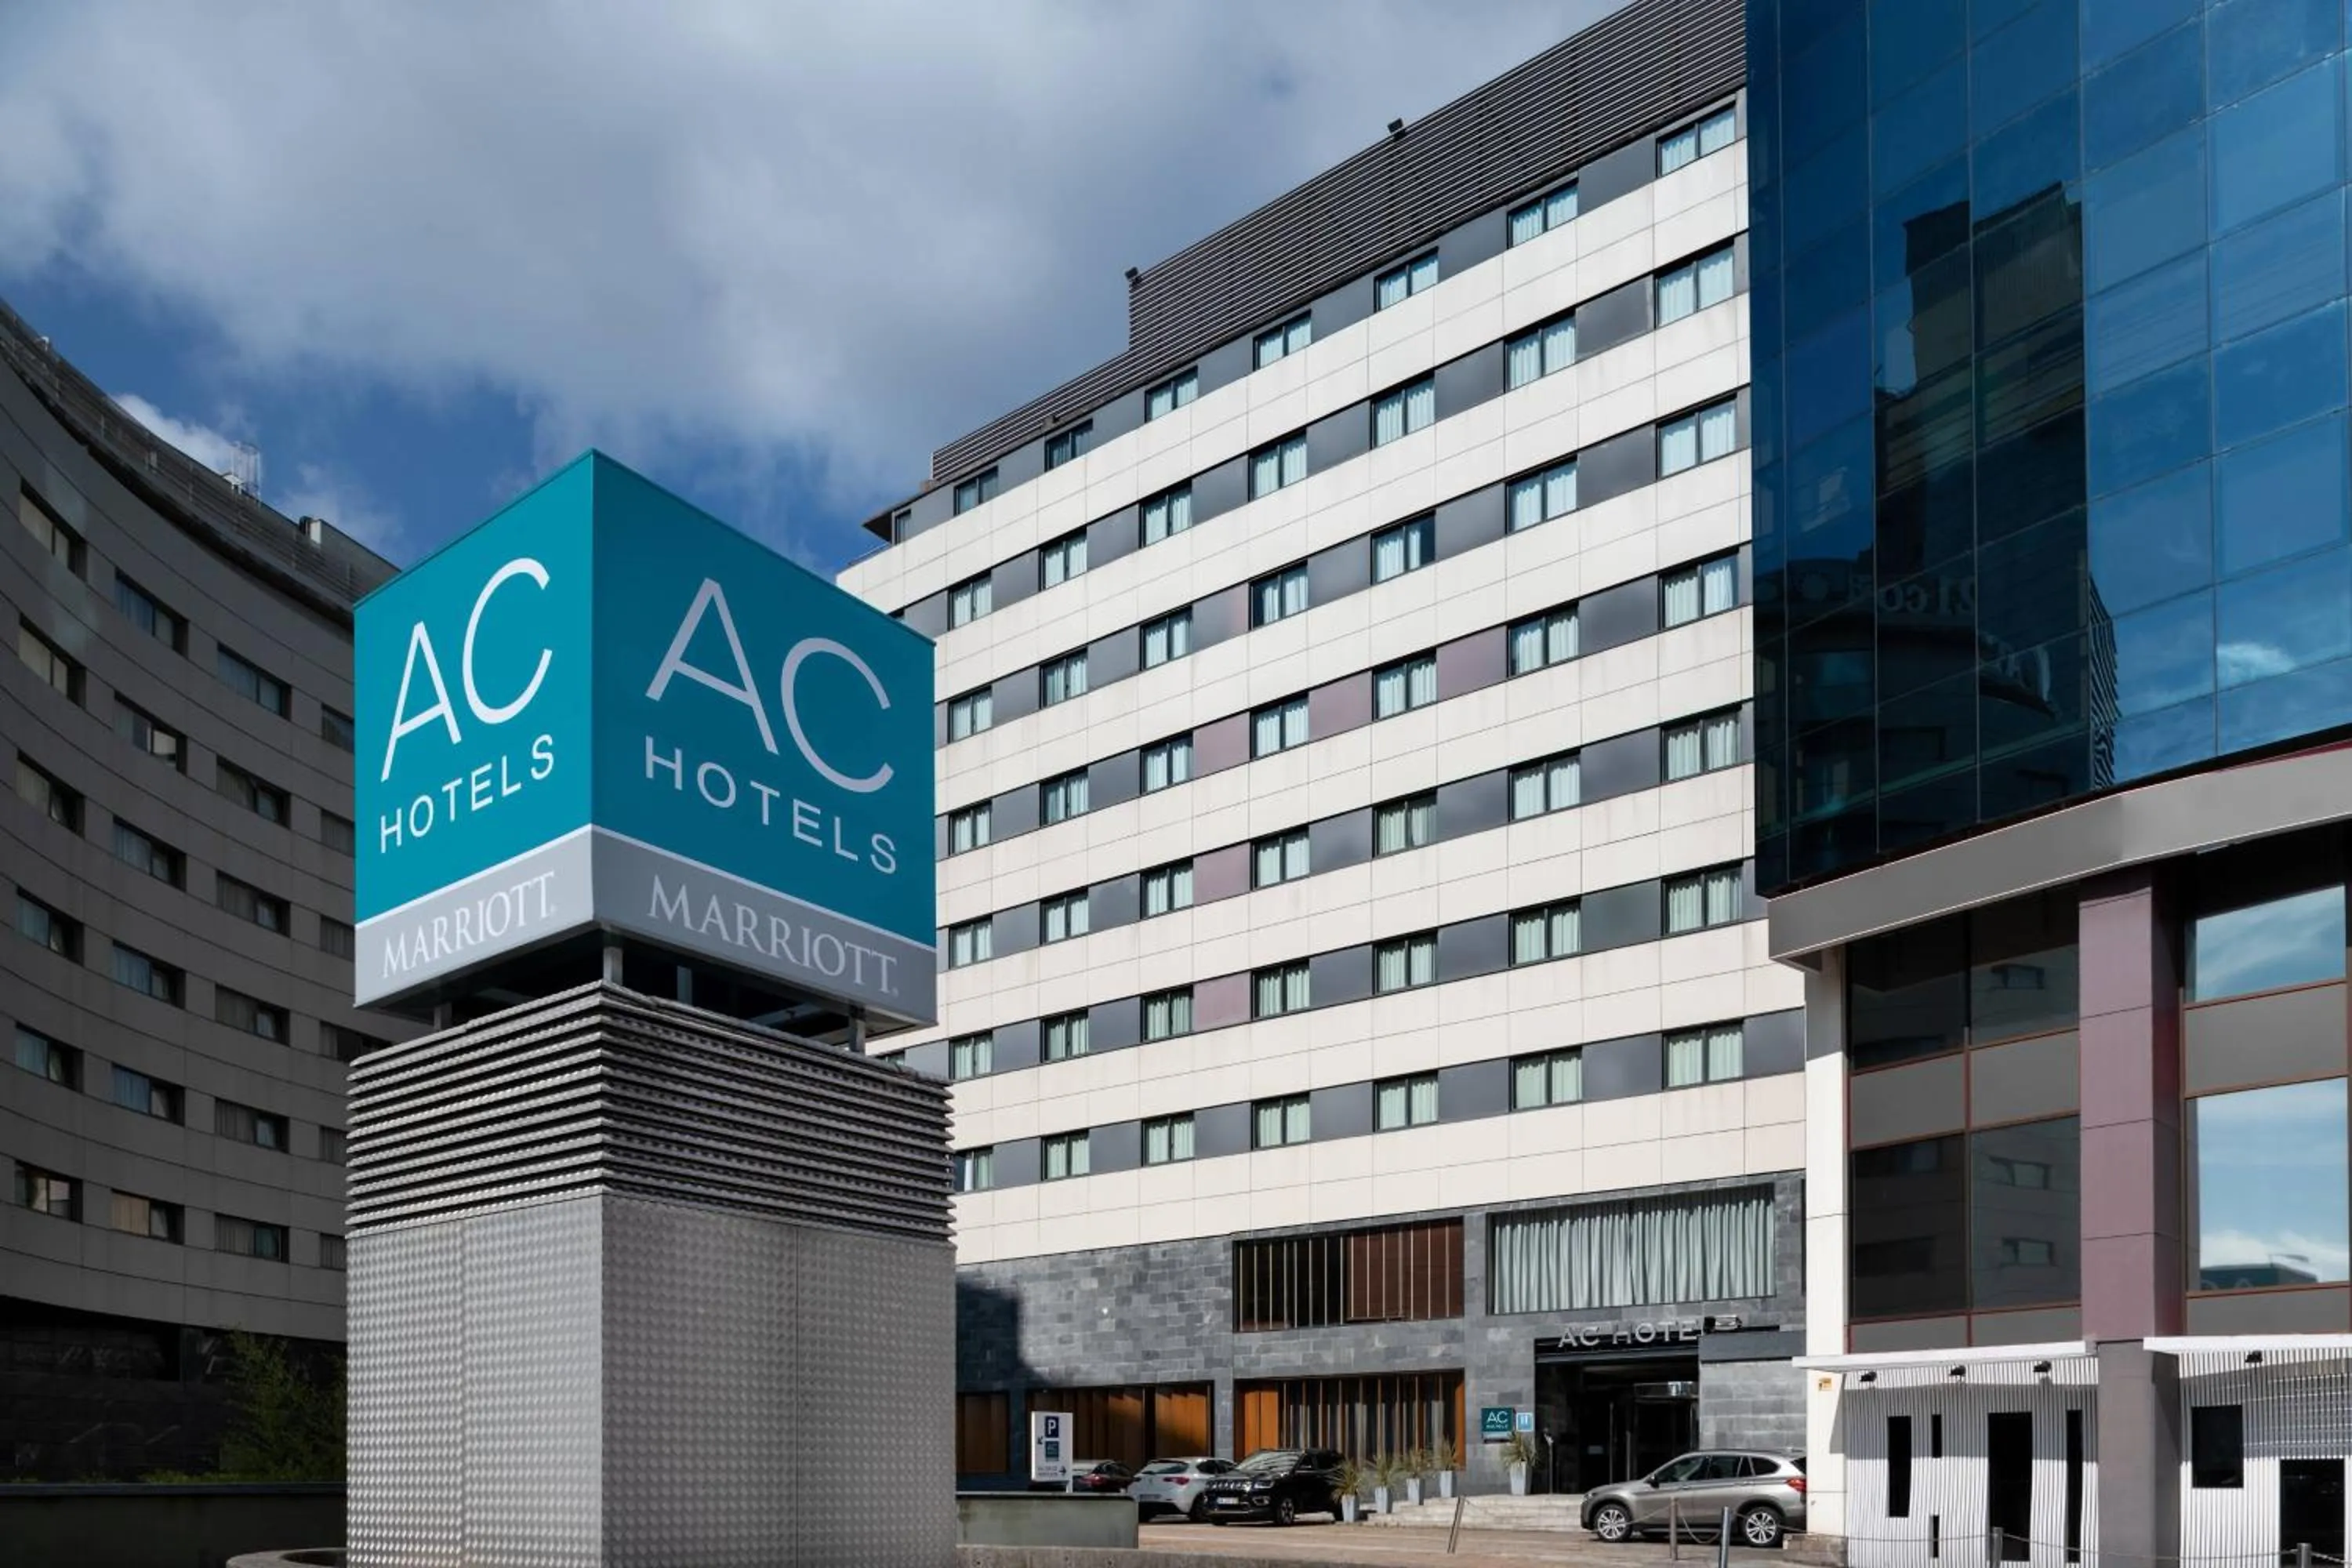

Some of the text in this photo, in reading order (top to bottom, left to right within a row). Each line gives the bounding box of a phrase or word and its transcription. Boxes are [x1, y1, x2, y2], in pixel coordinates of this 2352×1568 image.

[381, 557, 553, 782] AC
[645, 577, 895, 793] AC
[380, 734, 555, 854] HOTELS
[645, 736, 898, 875] HOTELS
[383, 870, 555, 978] MARRIOTT
[647, 874, 898, 994] MARRIOTT
[1558, 1325, 1600, 1348] AC
[1047, 1419, 1056, 1436] P
[1486, 1410, 1508, 1424] AC
